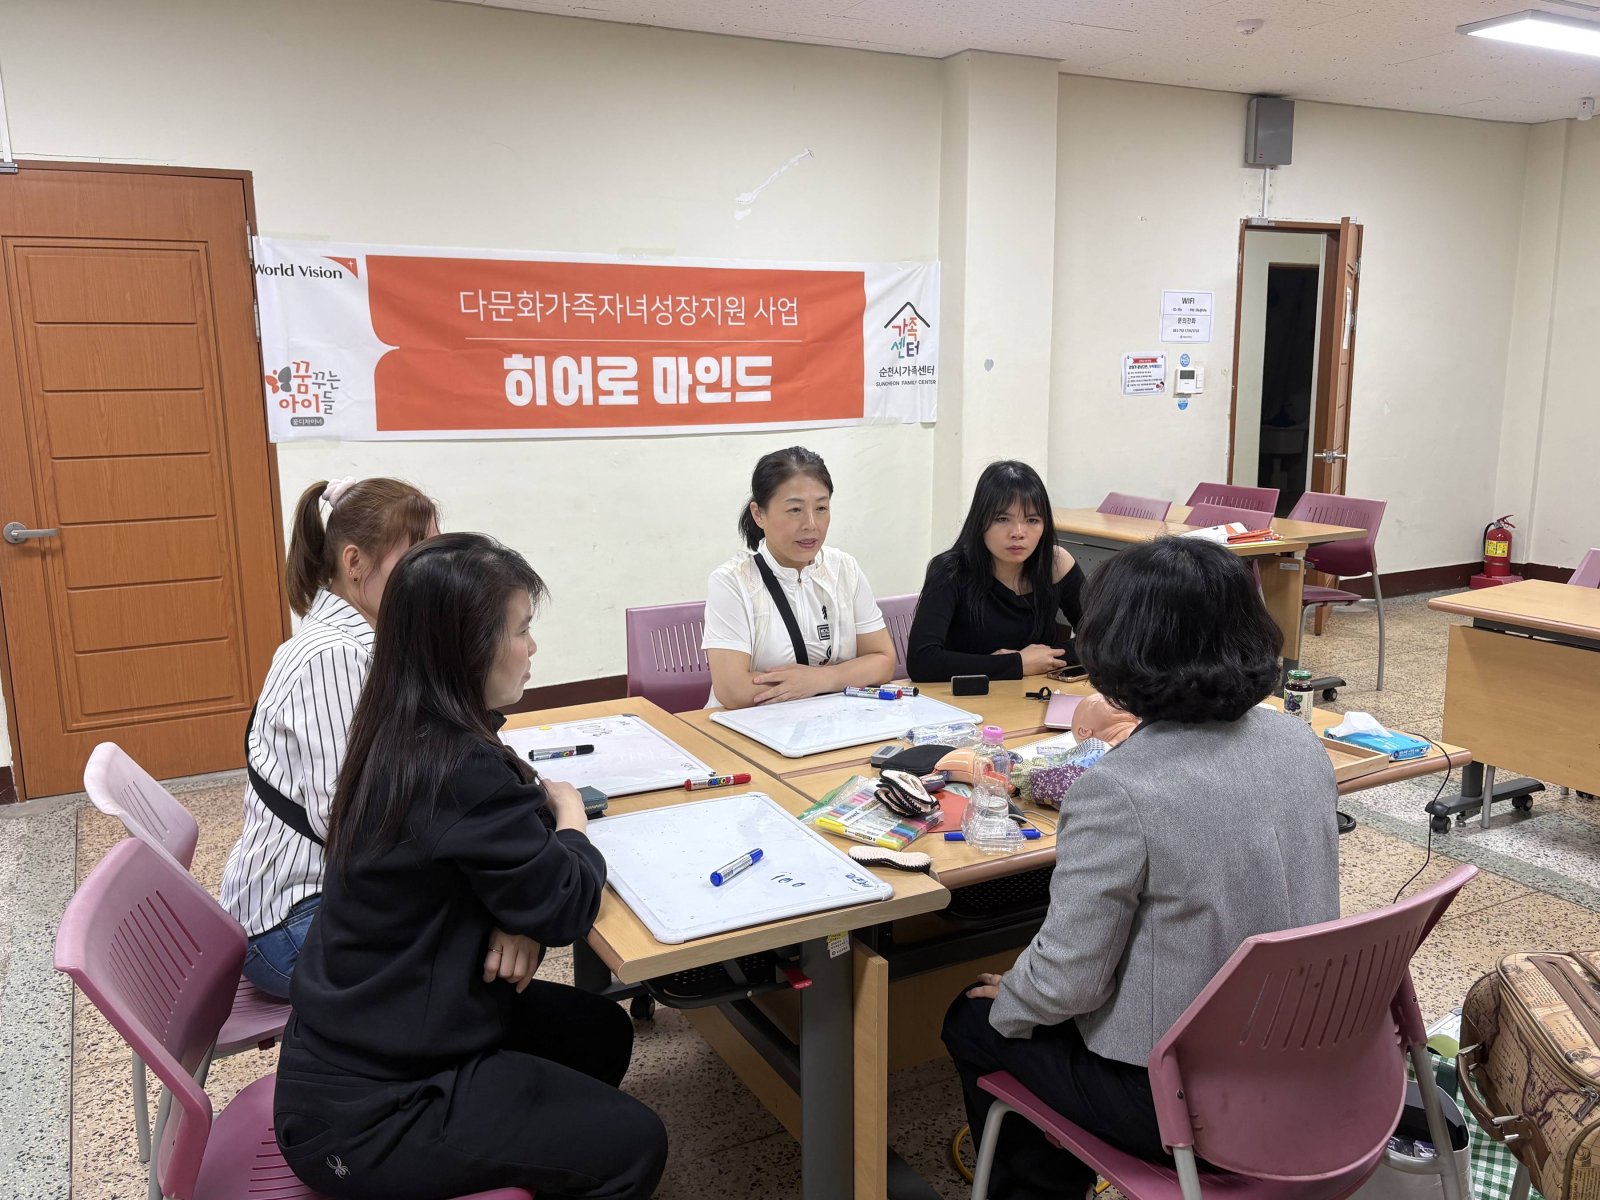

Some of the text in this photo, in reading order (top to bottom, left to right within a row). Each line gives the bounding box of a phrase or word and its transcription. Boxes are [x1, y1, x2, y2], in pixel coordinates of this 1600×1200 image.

[255, 263, 343, 279] World Vision
[459, 289, 799, 327] 다문화가족자녀성장지원 사업
[891, 317, 918, 342] 가족
[890, 336, 920, 359] 센터
[503, 353, 773, 407] 히어로 마인드
[878, 365, 935, 378] 순천시가족센터
[278, 393, 336, 415] 아이들
